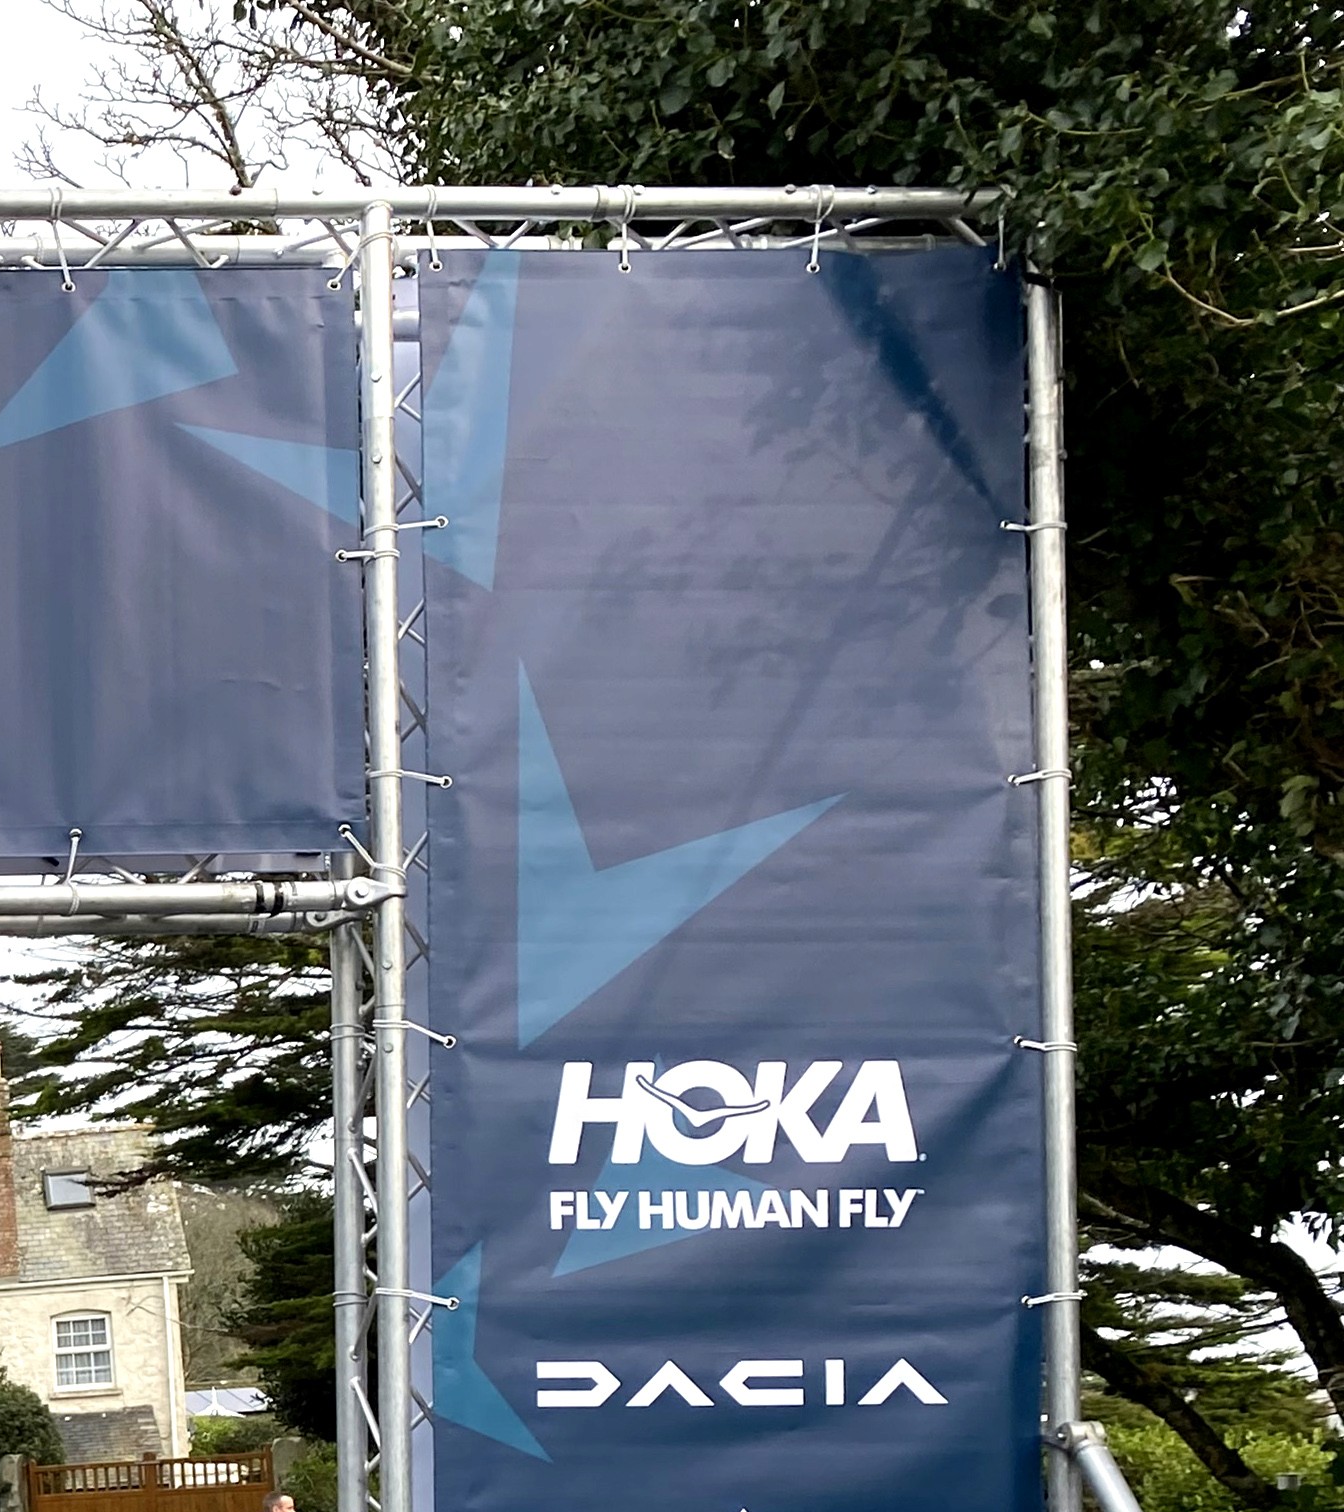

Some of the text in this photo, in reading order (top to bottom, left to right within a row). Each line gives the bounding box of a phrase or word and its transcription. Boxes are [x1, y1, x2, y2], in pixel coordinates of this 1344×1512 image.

[548, 1059, 919, 1166] HOKA
[550, 1188, 918, 1231] FLY HUMAN FLY
[536, 1357, 949, 1408] DACIA
